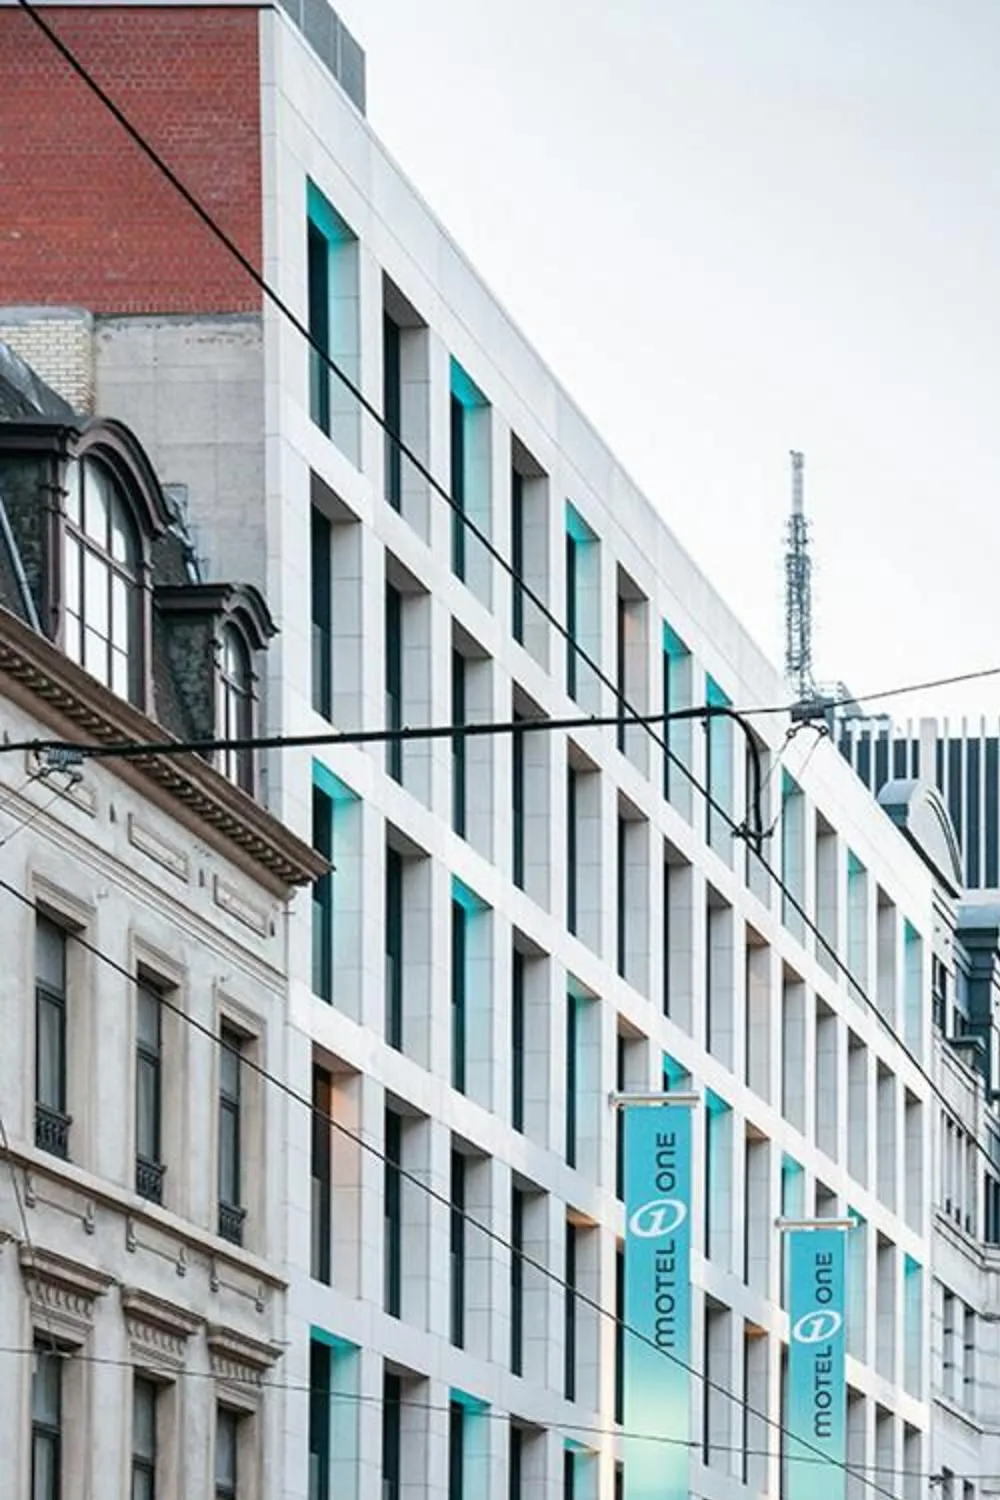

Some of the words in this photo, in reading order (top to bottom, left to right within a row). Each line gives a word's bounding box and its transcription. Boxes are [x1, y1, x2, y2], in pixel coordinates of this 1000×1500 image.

[656, 1132, 675, 1192] ONE
[655, 1239, 675, 1348] MOTEL
[815, 1252, 832, 1304] ONE
[814, 1345, 832, 1438] MOTEL
